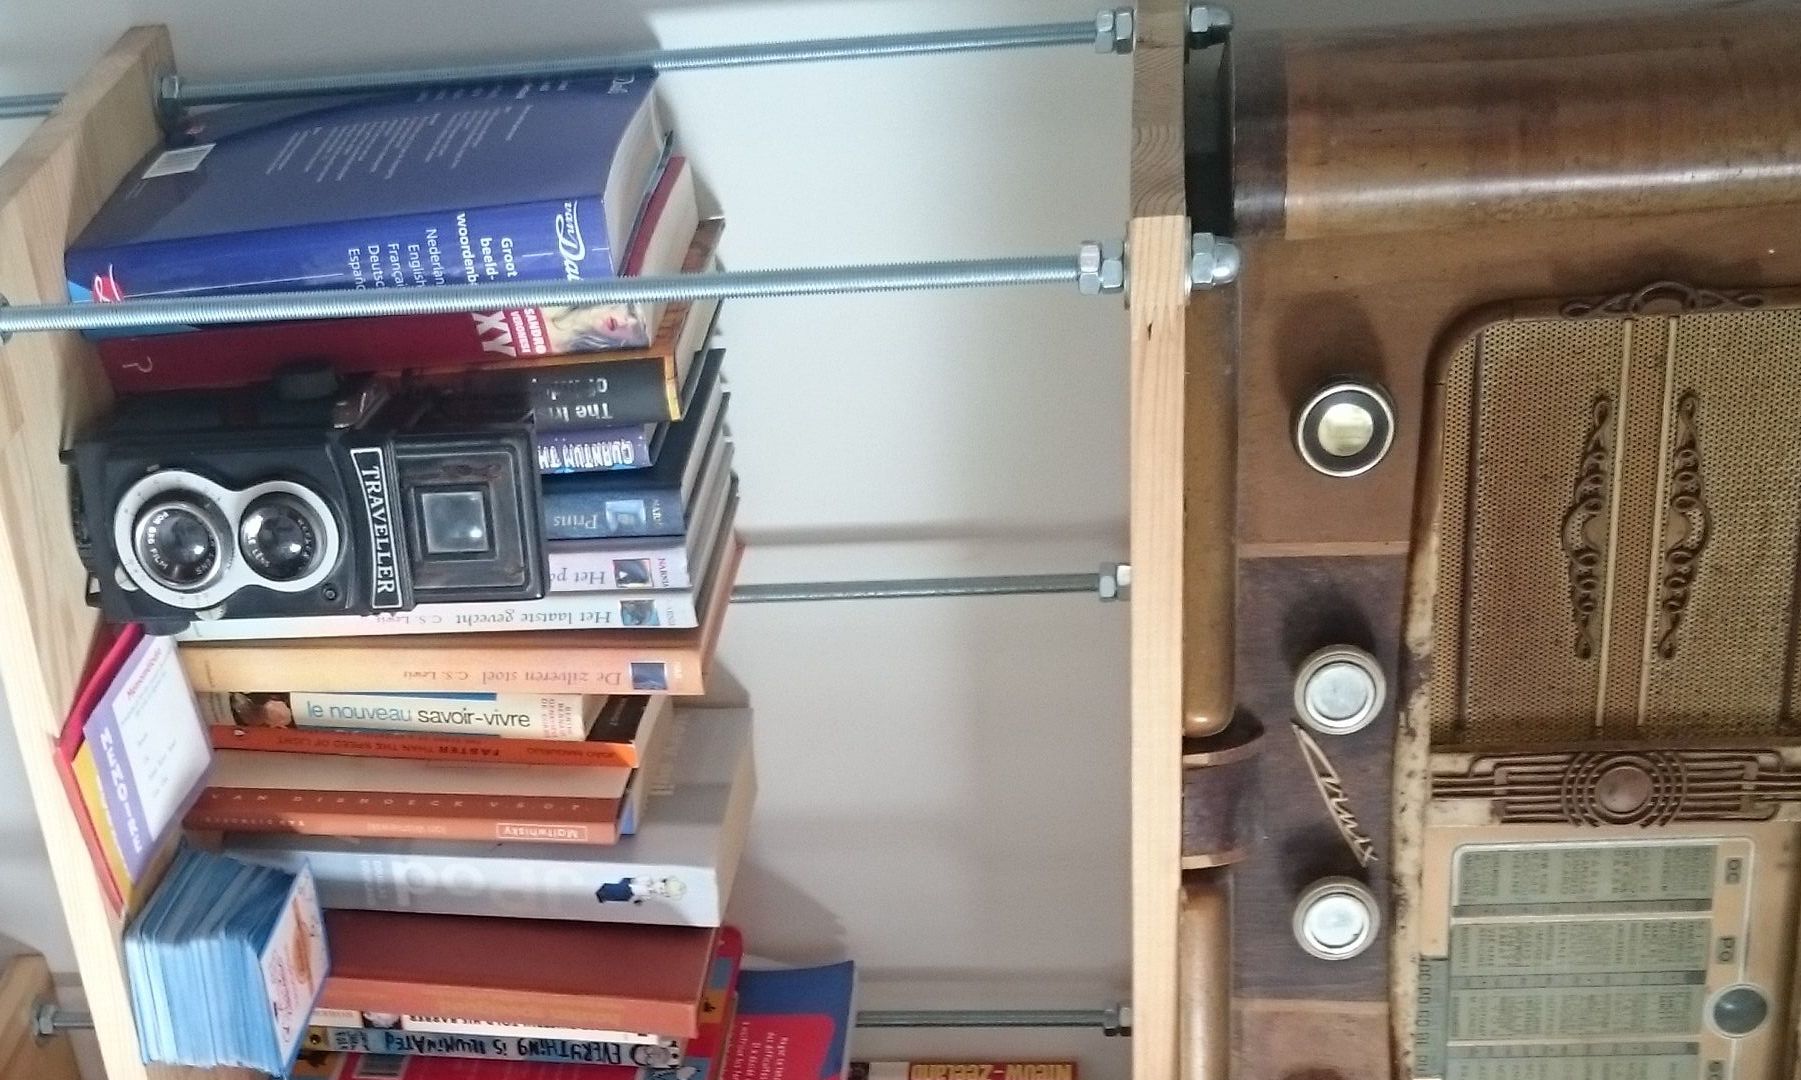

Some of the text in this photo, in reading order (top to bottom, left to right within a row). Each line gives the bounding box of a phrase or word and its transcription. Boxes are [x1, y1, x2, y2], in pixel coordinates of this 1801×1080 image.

[425, 228, 446, 286] Nederlan
[456, 211, 479, 286] woordenb
[480, 237, 498, 281] beeld-
[500, 237, 519, 278] Groot
[367, 244, 386, 288] Deutsc
[387, 242, 408, 288] Françai
[472, 309, 517, 358] XY
[522, 307, 549, 355] SANDRO
[576, 403, 613, 420] The
[562, 437, 635, 468] QUANTUM
[360, 465, 396, 594] TRAVELLER
[552, 514, 600, 530] Prins
[577, 570, 607, 585] Het
[456, 610, 516, 626] gevecht
[528, 610, 574, 625] laatste
[580, 611, 612, 624] Het
[482, 669, 515, 685] stoel
[517, 669, 591, 686] zilveren
[599, 671, 622, 686] De
[305, 700, 324, 718] le
[329, 703, 413, 723] nouveau
[417, 705, 531, 728] savoir-vivre
